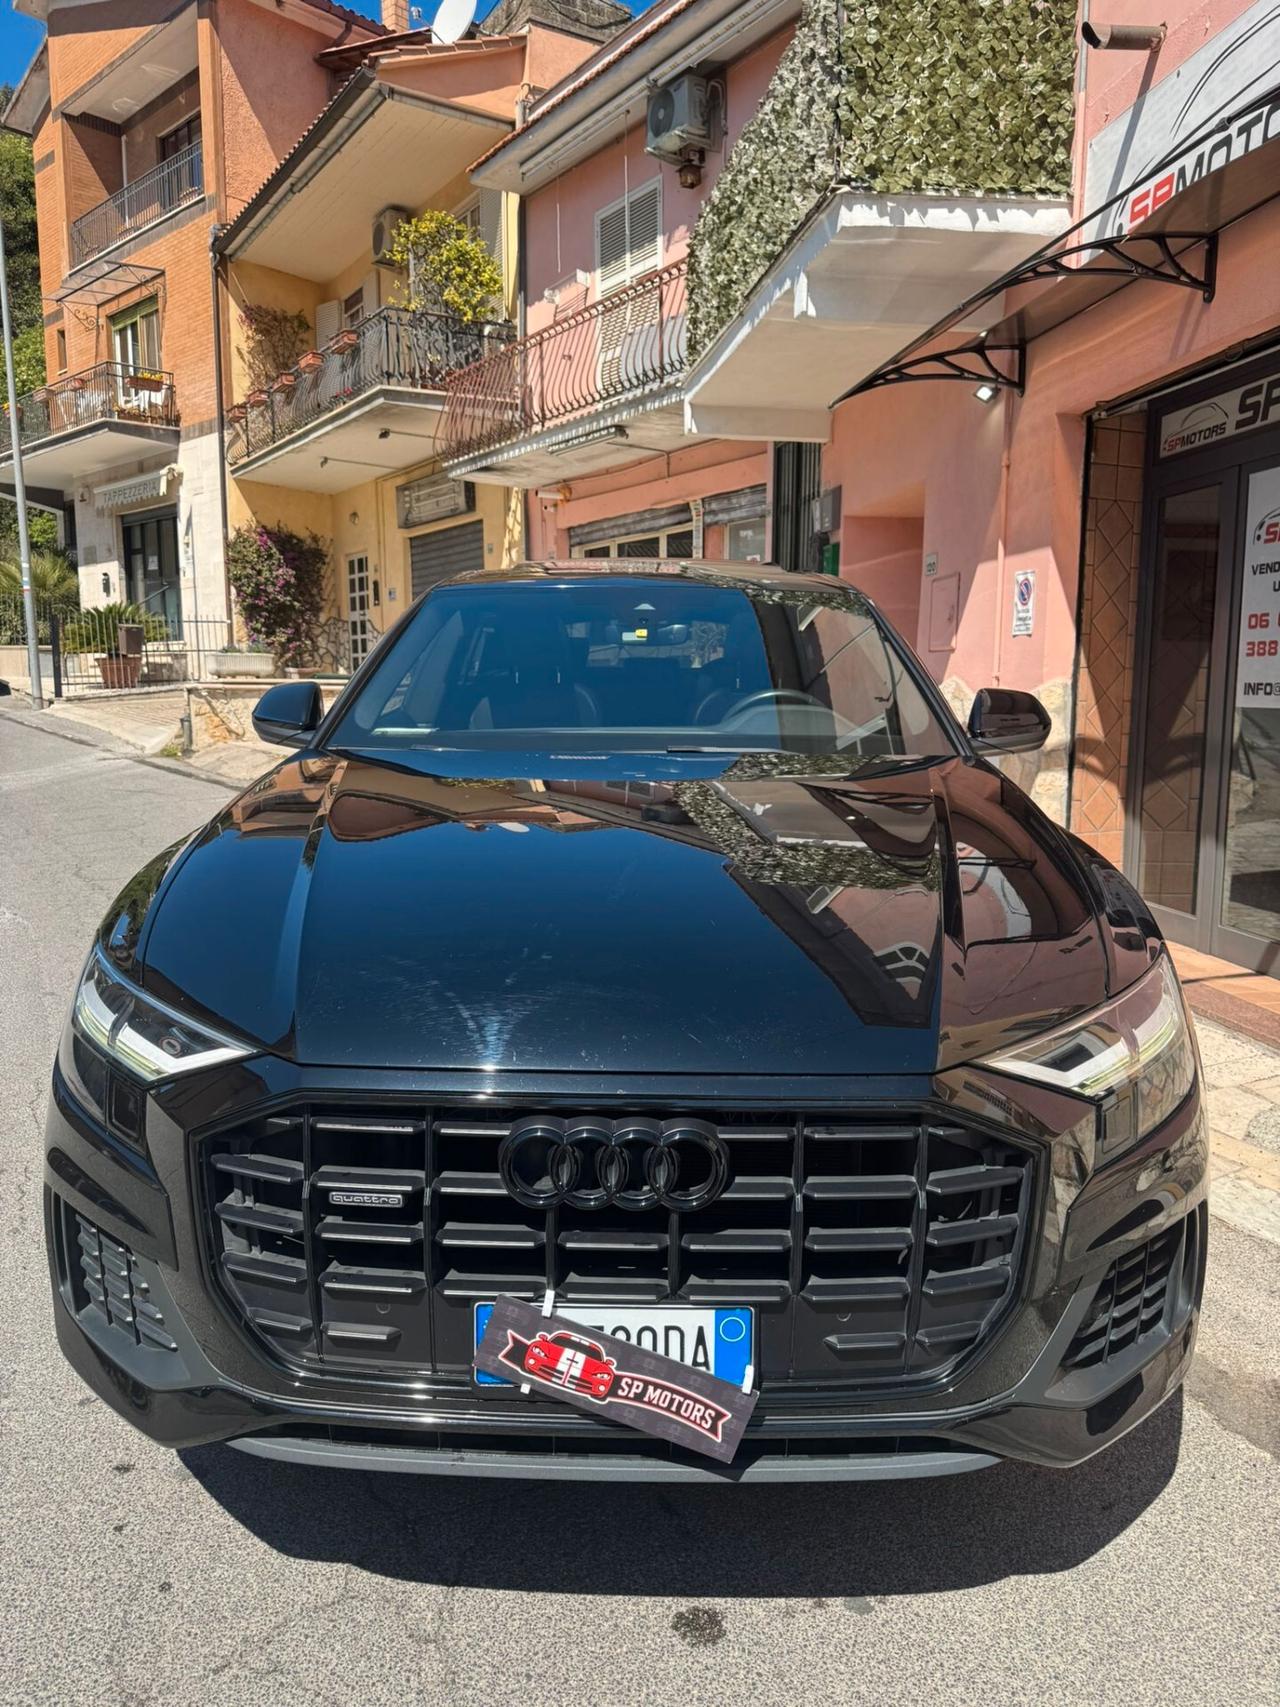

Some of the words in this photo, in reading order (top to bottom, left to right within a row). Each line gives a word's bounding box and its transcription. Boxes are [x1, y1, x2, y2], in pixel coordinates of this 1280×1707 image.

[1166, 422, 1227, 452] SPMOTORS
[1248, 612, 1269, 629] 06
[1246, 640, 1278, 657] 388
[332, 1195, 397, 1204] quattro
[618, 1377, 643, 1398] SP
[643, 1385, 716, 1429] MOTORS
